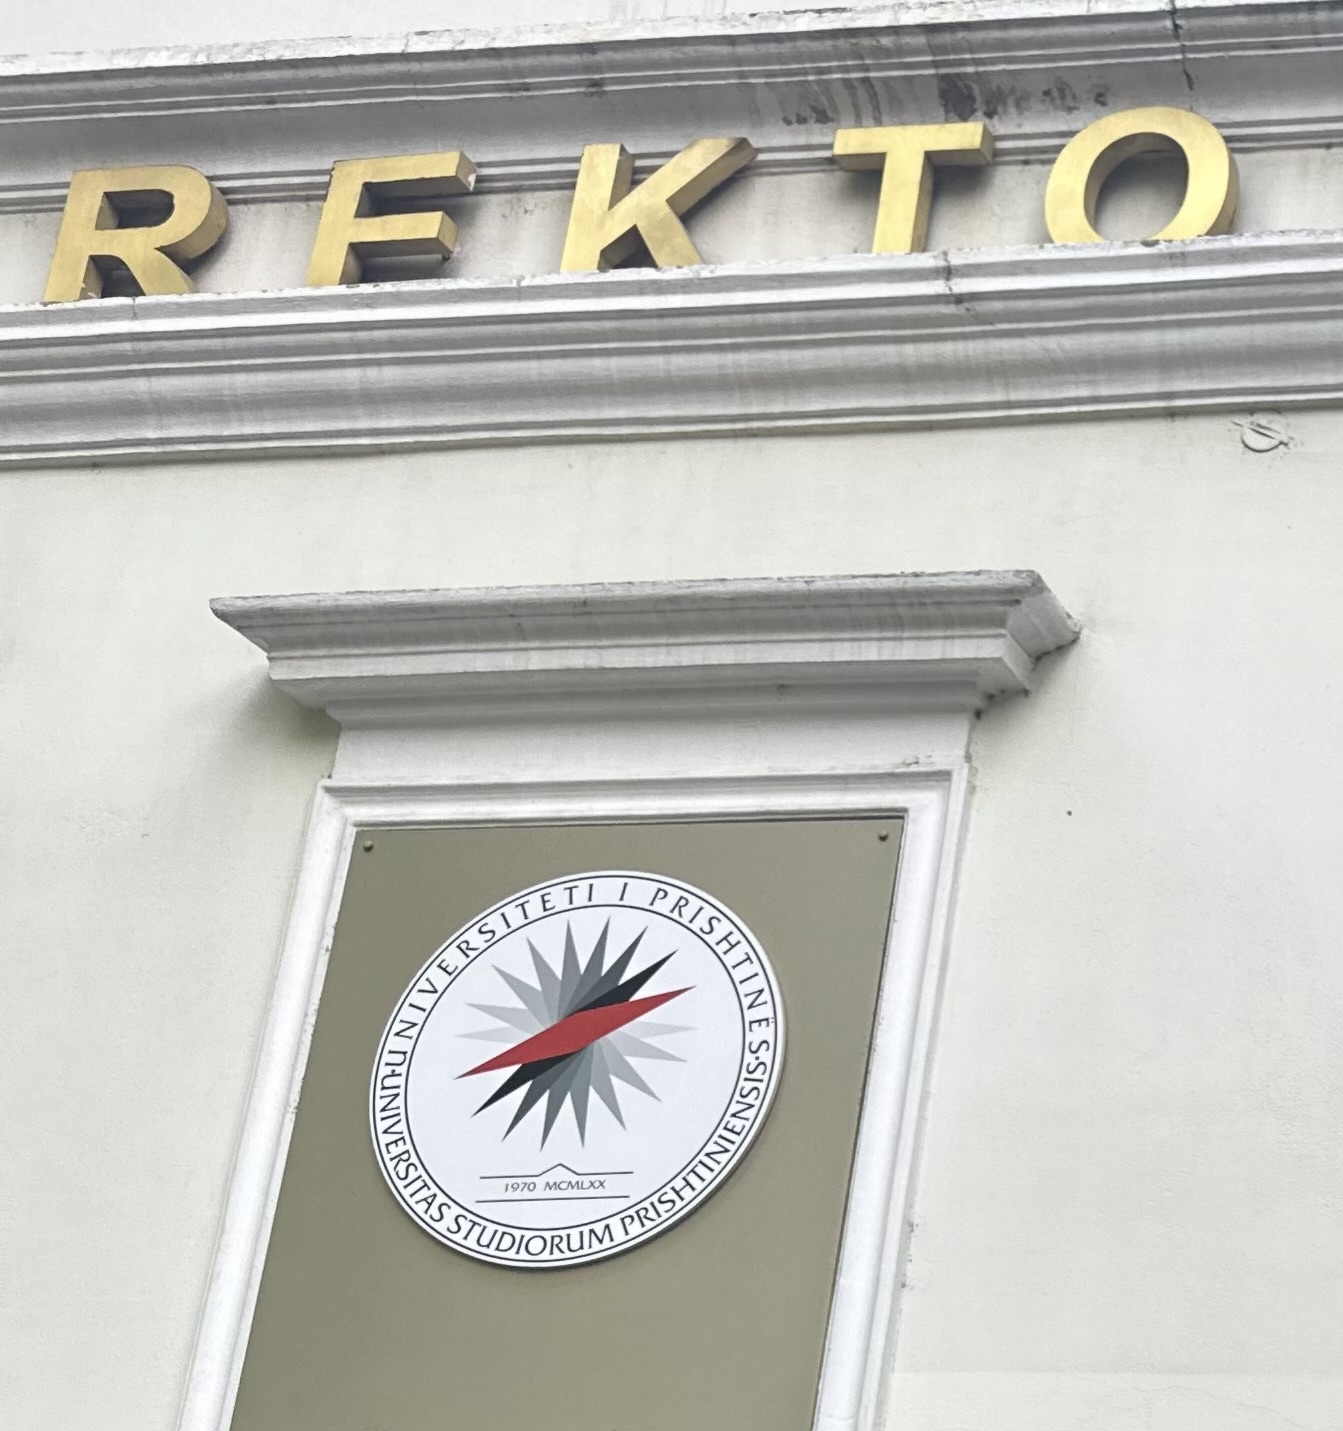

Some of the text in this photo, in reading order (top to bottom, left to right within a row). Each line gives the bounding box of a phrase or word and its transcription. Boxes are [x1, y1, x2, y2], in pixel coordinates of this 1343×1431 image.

[385, 882, 775, 1067] UNIVERSITETI I PRISHTINËS
[379, 1061, 768, 1256] UNIVERSITAS STUDIORUM PRISHTINIENSIS
[504, 1179, 607, 1193] 1970 MCMLXX
